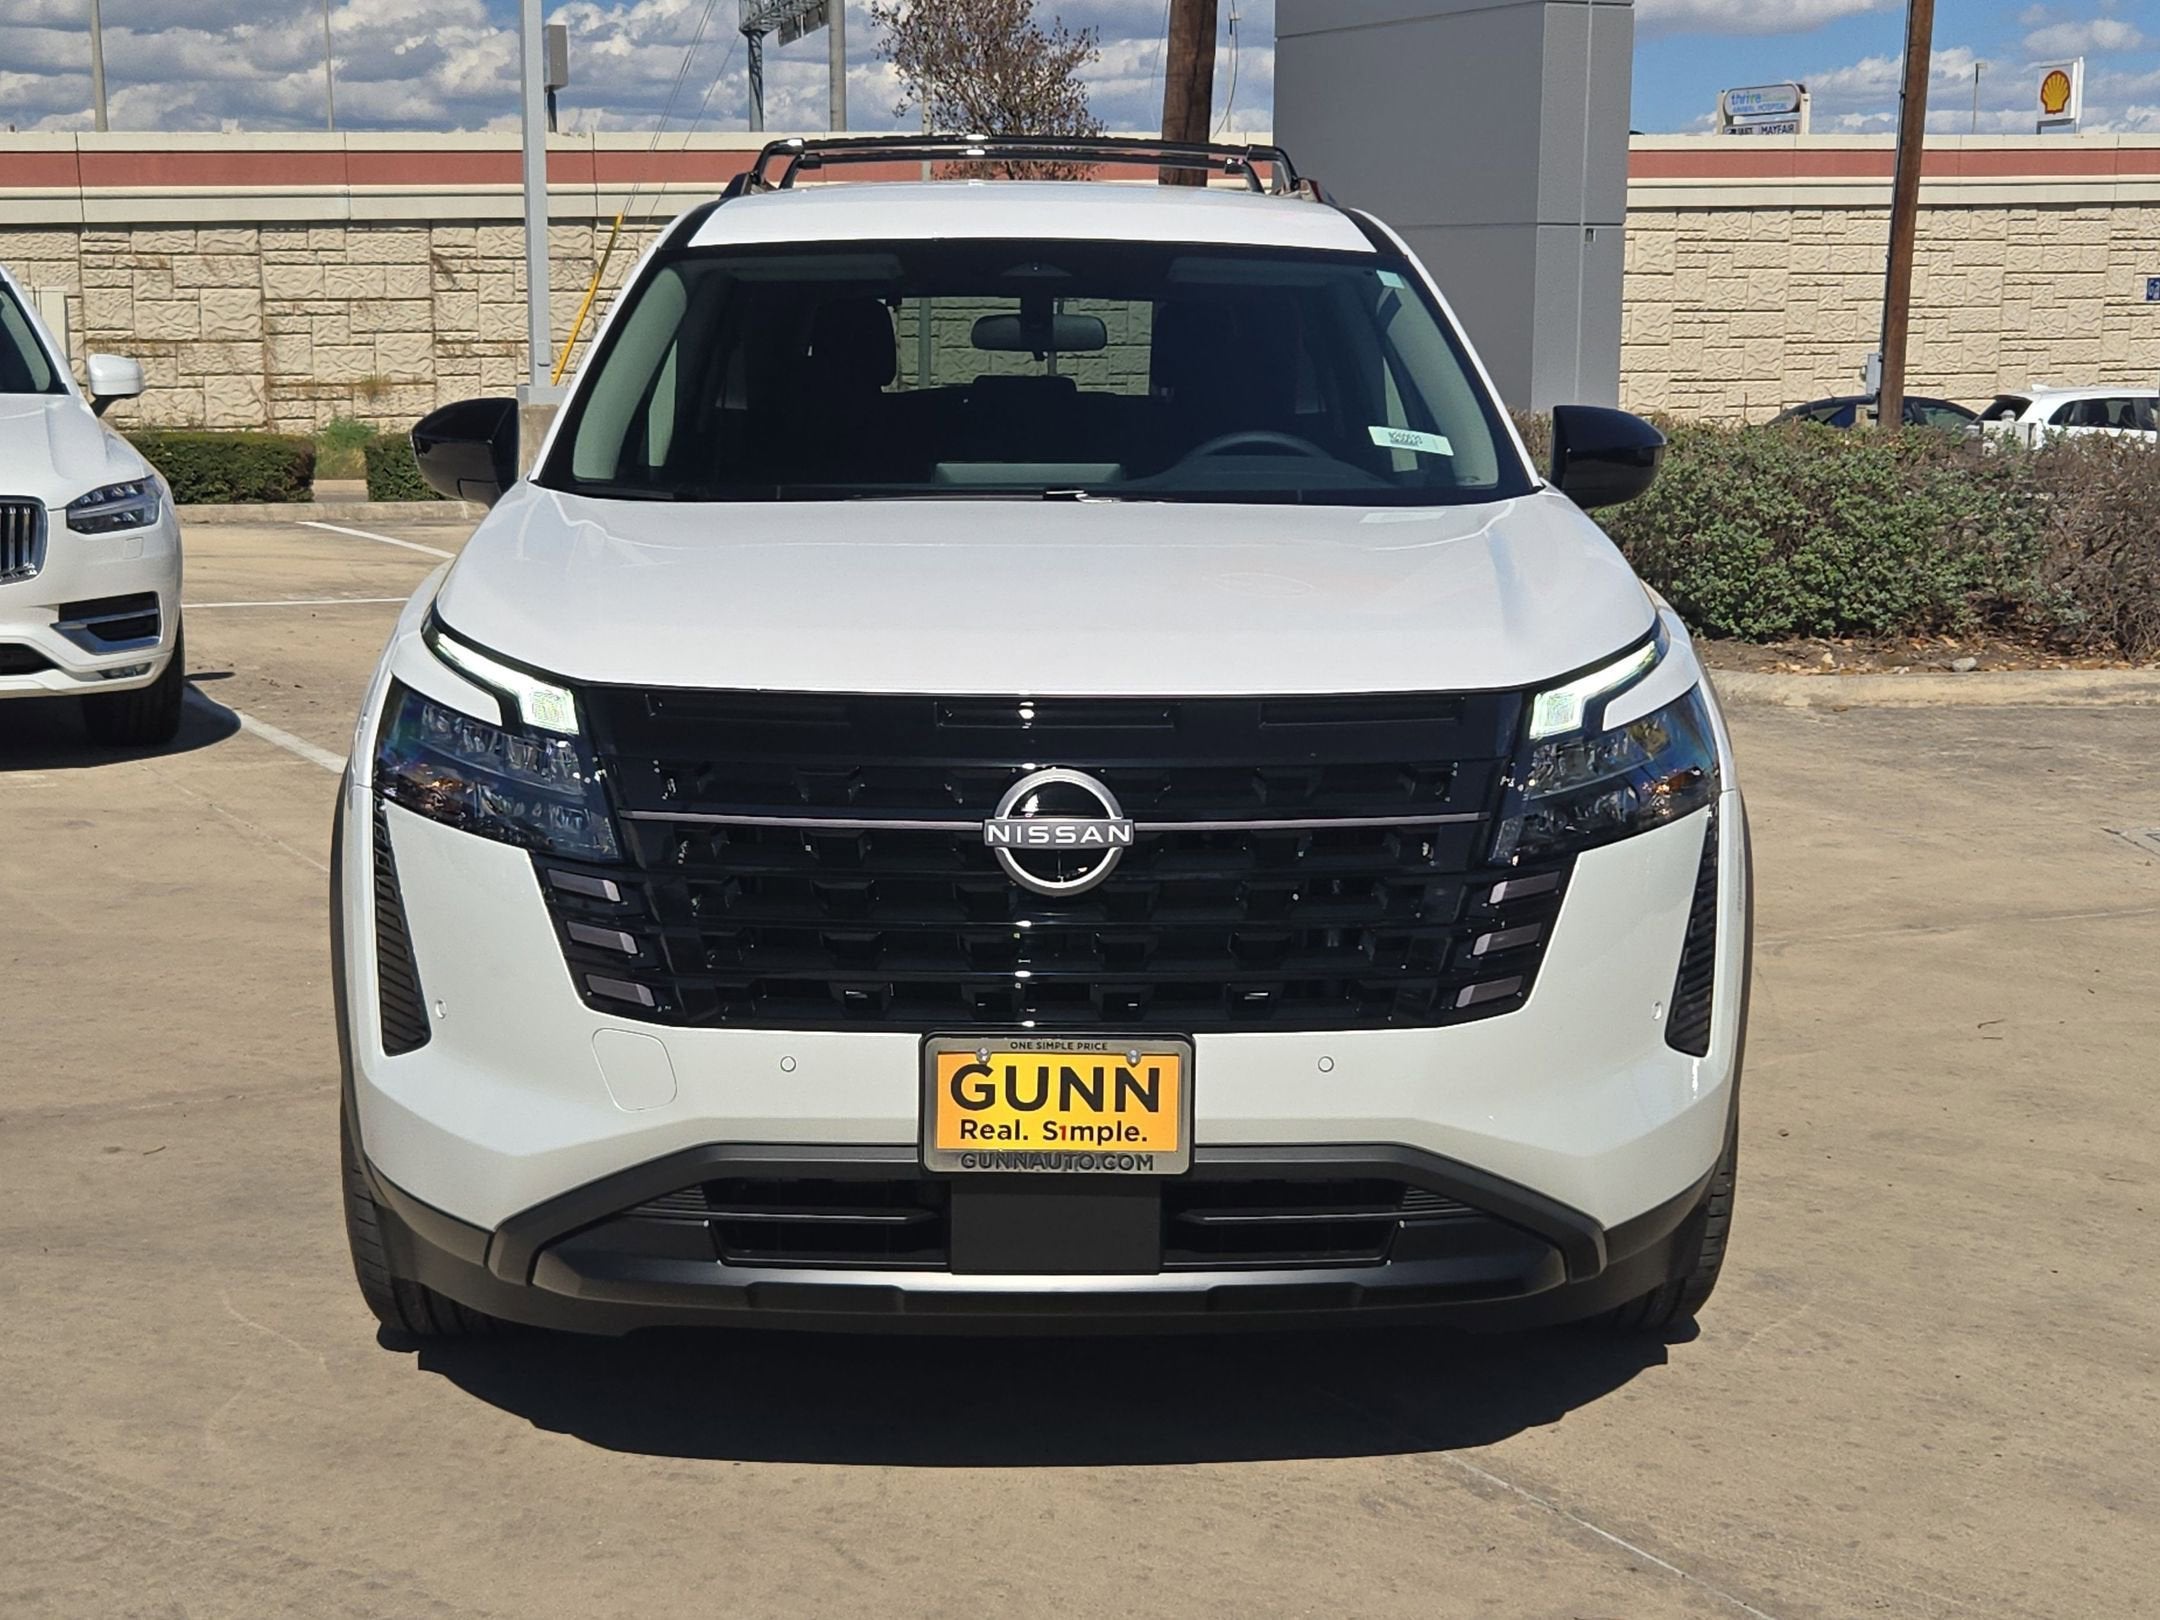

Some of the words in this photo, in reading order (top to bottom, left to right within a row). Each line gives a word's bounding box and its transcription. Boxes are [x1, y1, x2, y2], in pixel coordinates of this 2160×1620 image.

[1760, 123, 1795, 135] MAYFAIR
[987, 824, 1130, 844] NISSAN
[1009, 1041, 1033, 1050] ONE
[1036, 1041, 1074, 1051] SIMPLE
[1077, 1042, 1108, 1051] PRICE
[950, 1063, 1160, 1113] GUNN
[959, 1119, 1028, 1141] Real.
[960, 1152, 1154, 1171] GUNNAUTO.COM
